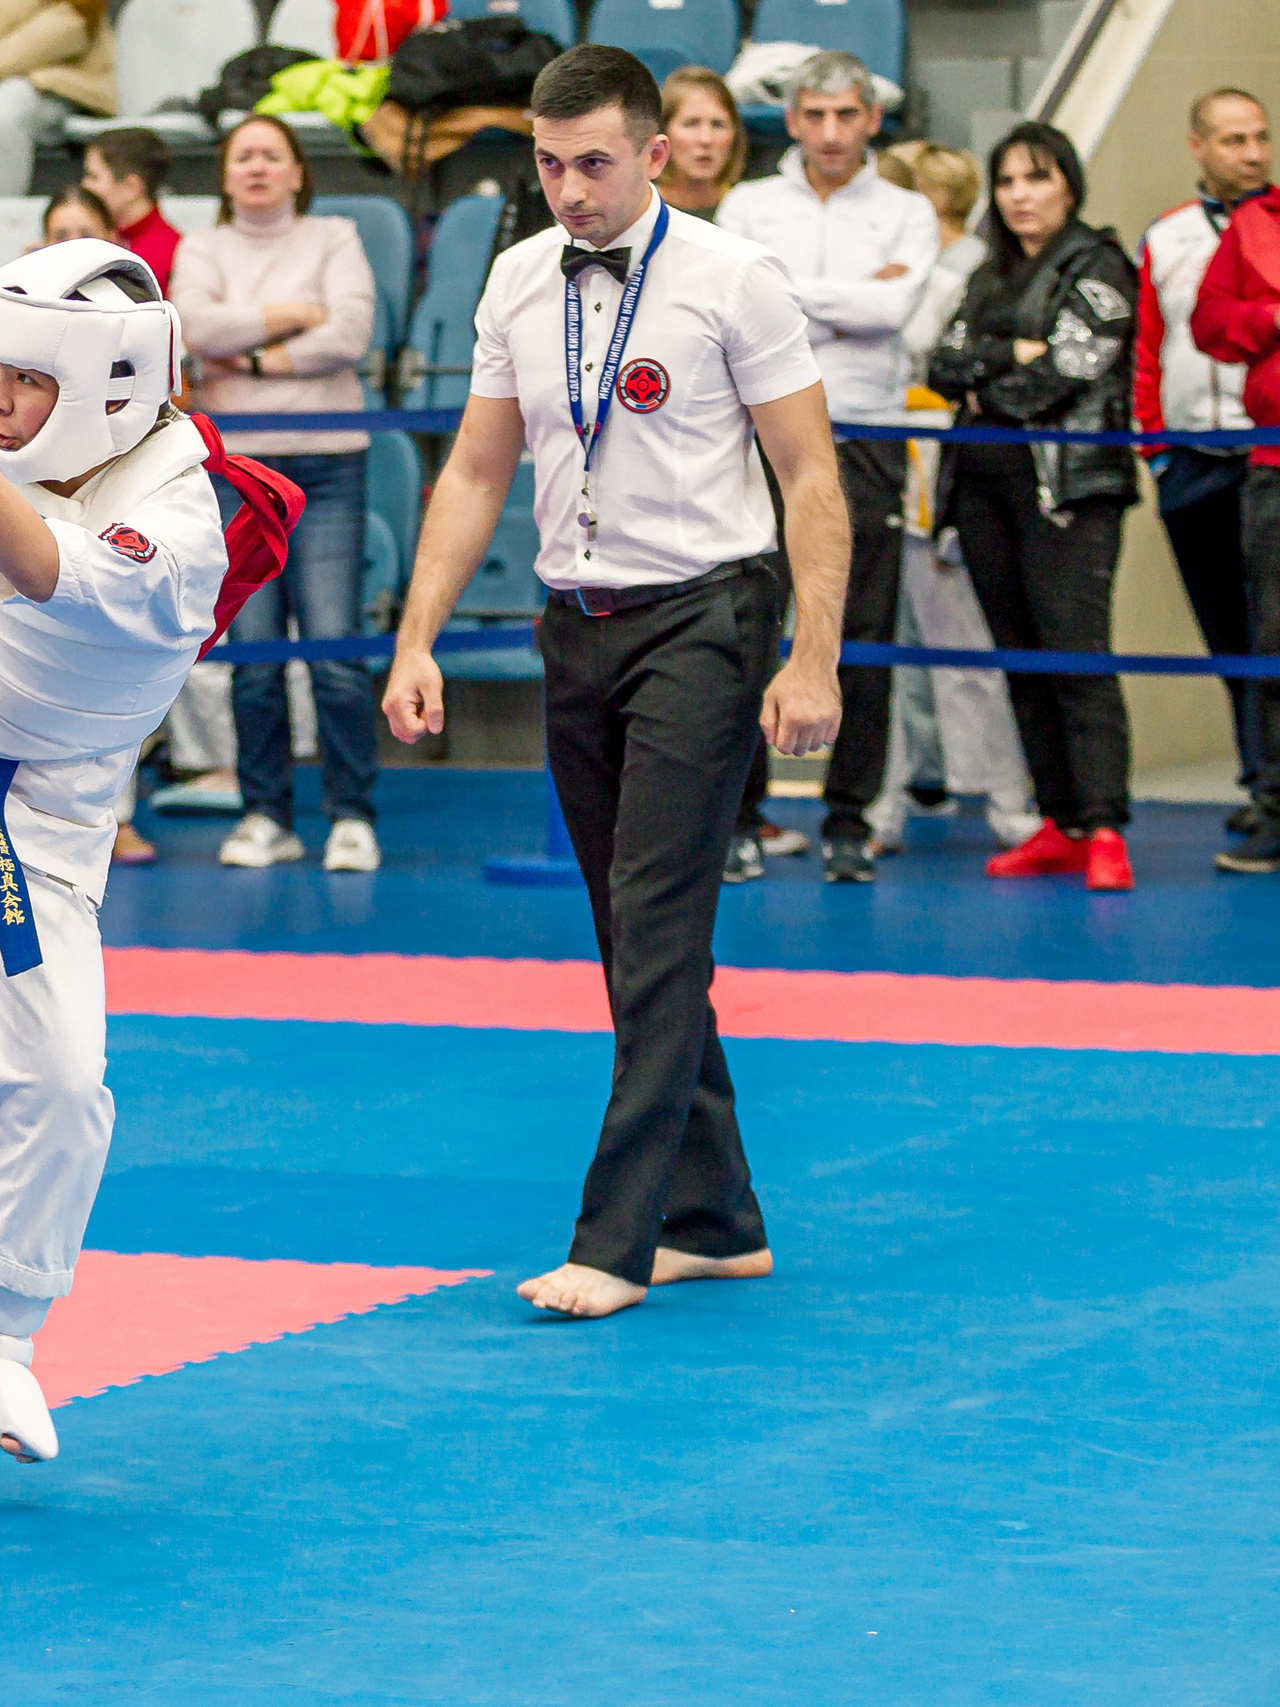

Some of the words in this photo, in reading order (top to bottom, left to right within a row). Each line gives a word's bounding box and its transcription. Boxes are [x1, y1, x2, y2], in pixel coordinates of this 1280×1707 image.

[567, 301, 579, 349] КИОКУШИН
[606, 316, 631, 364] КИОКУШИН
[568, 351, 580, 402] ФЕДЕРАЦИЯ
[599, 364, 616, 400] РОССИИ
